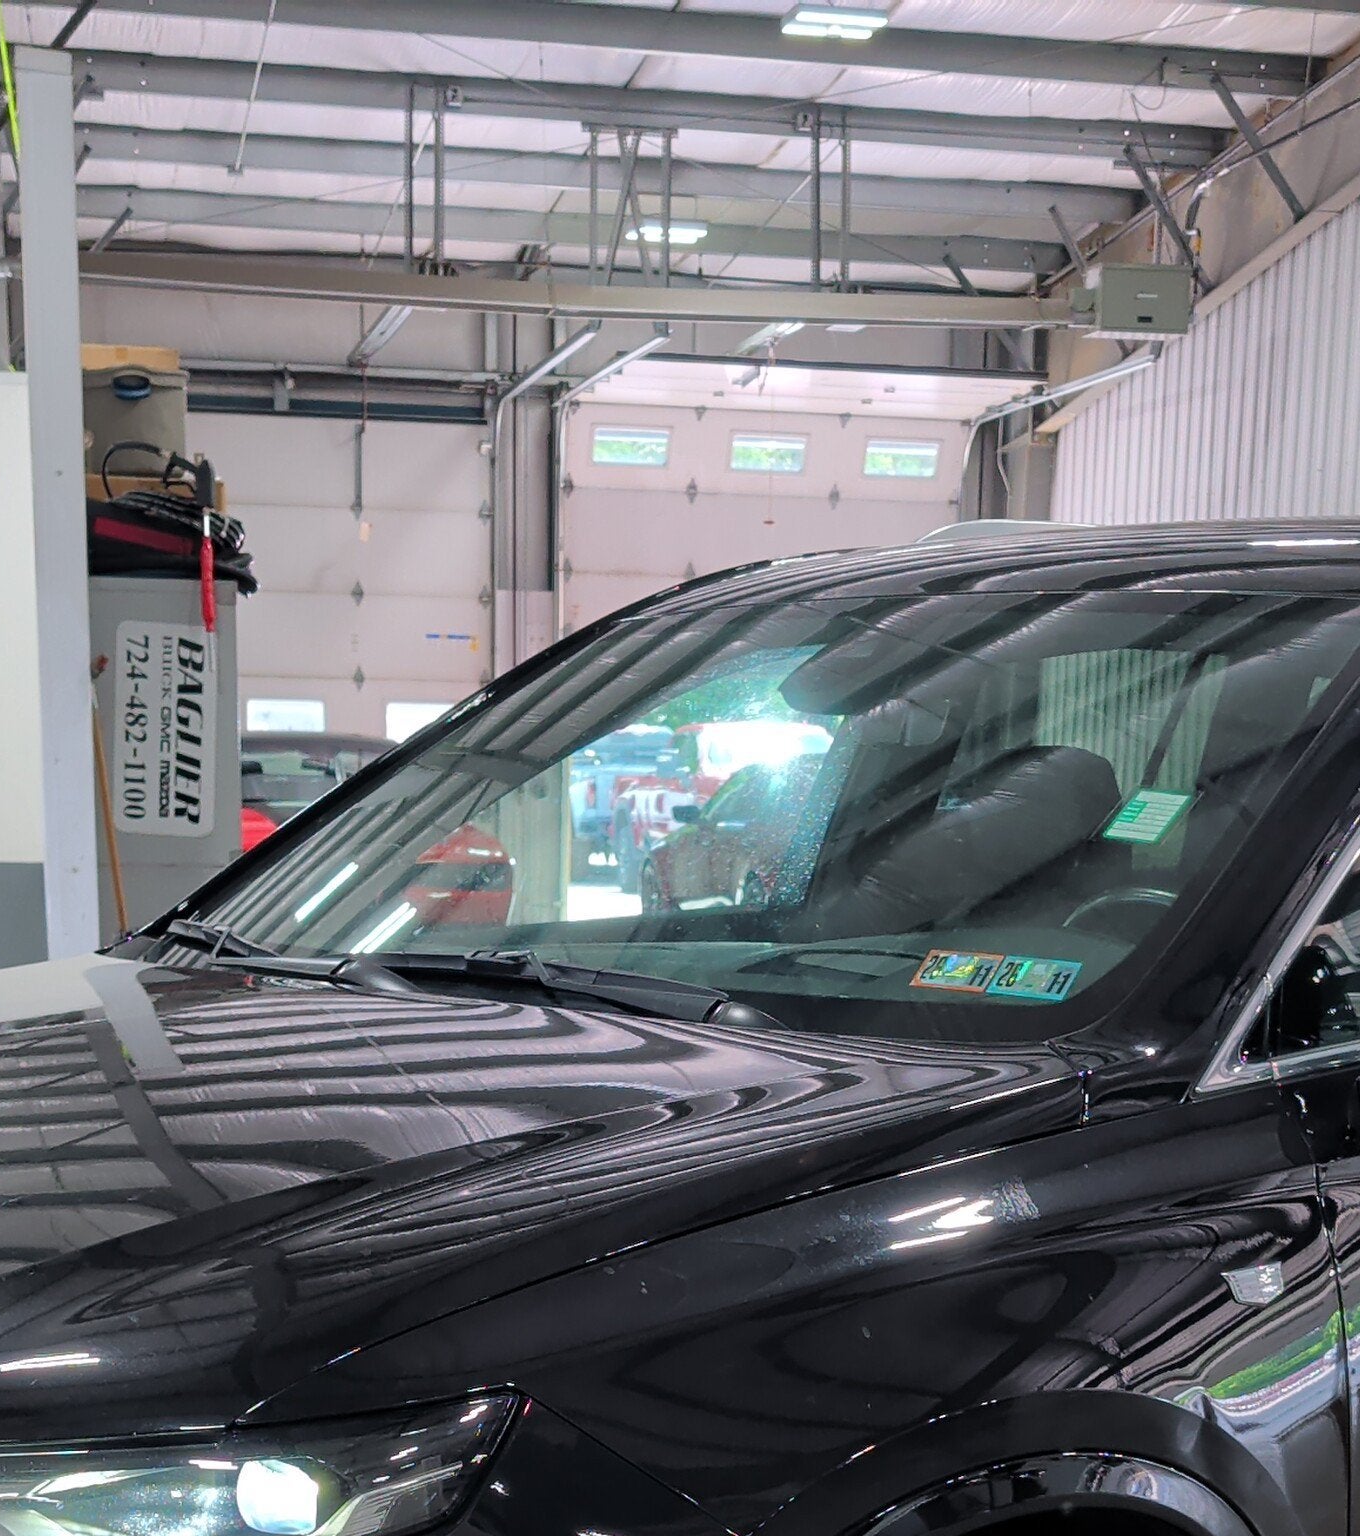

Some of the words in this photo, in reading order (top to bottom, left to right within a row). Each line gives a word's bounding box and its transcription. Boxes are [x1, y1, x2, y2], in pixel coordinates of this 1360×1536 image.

[123, 634, 150, 820] 724-482-1100
[159, 706, 172, 753] GMC
[160, 636, 173, 700] BUICK
[174, 637, 205, 825] BAGLIER
